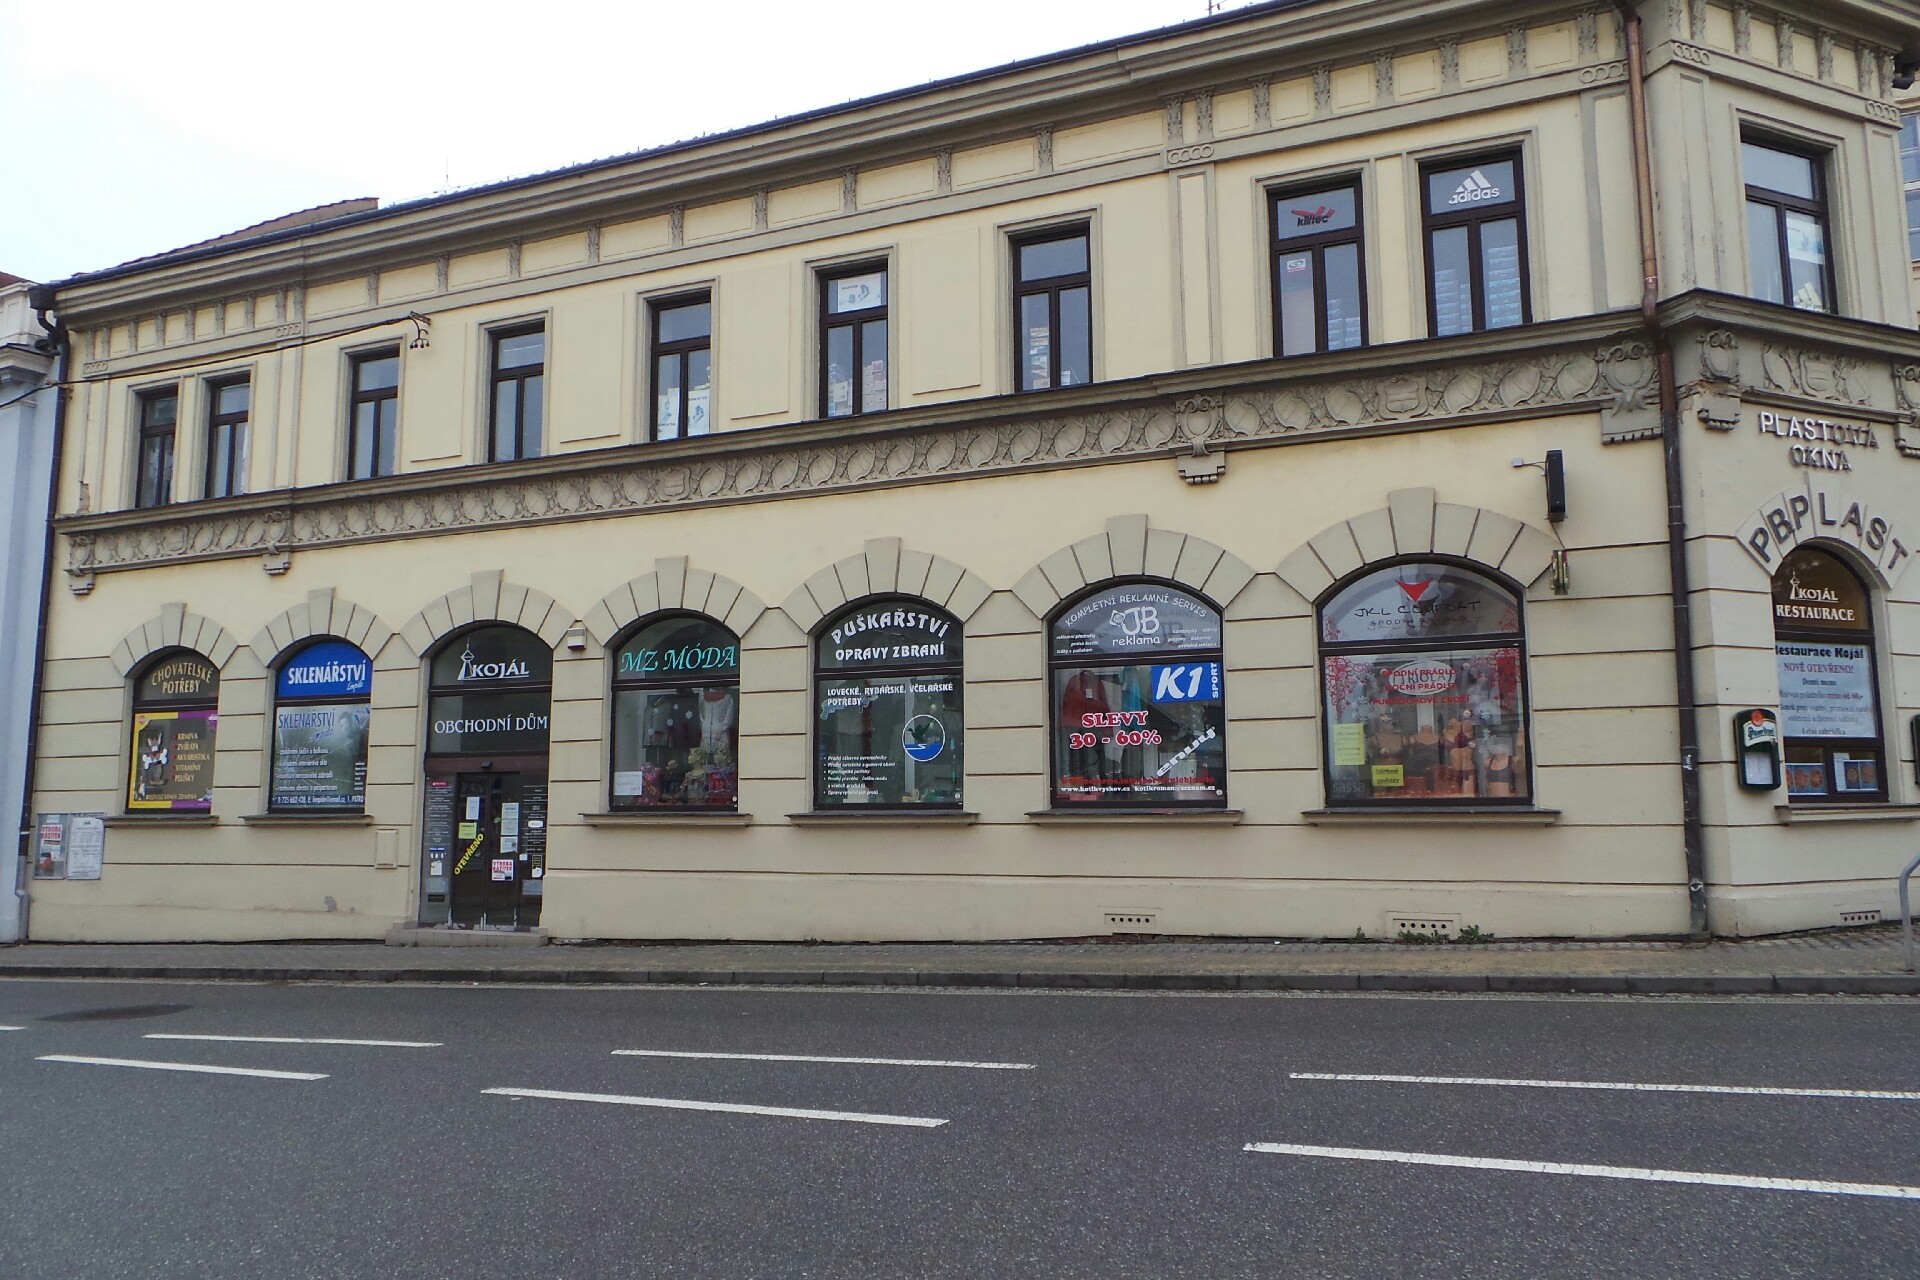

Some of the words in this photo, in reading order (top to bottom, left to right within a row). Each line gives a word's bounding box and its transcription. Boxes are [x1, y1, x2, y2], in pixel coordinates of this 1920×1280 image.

[1449, 188, 1500, 204] adidas
[1759, 411, 1880, 449] PLASTOVÁ
[1790, 443, 1853, 471] OKNA
[1749, 492, 1909, 569] PBPLAST
[1800, 587, 1838, 601] KOJÁL
[1065, 596, 1117, 627] KOMPLETNÍ
[1120, 593, 1169, 604] REKLAMNÍ
[1172, 597, 1207, 618] SERVIS
[1776, 604, 1855, 621] RESTAURACE
[830, 608, 951, 645] PUŠKAŘSTVÍ
[1122, 606, 1160, 636] JB
[835, 646, 888, 661] OPRAVY
[893, 641, 945, 659] ZBRANÍ
[1112, 635, 1161, 647] reklama
[472, 659, 530, 677] KOJÁL
[620, 648, 658, 672] MZ
[663, 643, 736, 671] MÓDA
[152, 662, 213, 686] CHOVATELSKÉ
[288, 659, 366, 685] SKLENÁŘSTVÍ
[1156, 665, 1203, 700] K1
[1210, 663, 1219, 698] SPORT
[162, 678, 201, 694] POTŘEBY
[827, 687, 862, 697] LOVECKÉ,
[864, 684, 907, 696] RYBÁŘSKÉ,
[909, 681, 954, 693] VČELAŘSKÉ
[827, 696, 862, 707] POTŘEBY
[278, 708, 336, 728] SKLENÁŘSTVÍ
[434, 713, 512, 734] OBCHODNÍ
[516, 712, 548, 731] DŮM
[1081, 711, 1149, 728] SLEVY
[1069, 732, 1097, 750] 30
[1115, 729, 1162, 746] 60%
[453, 833, 484, 876] OTEVŘENO
